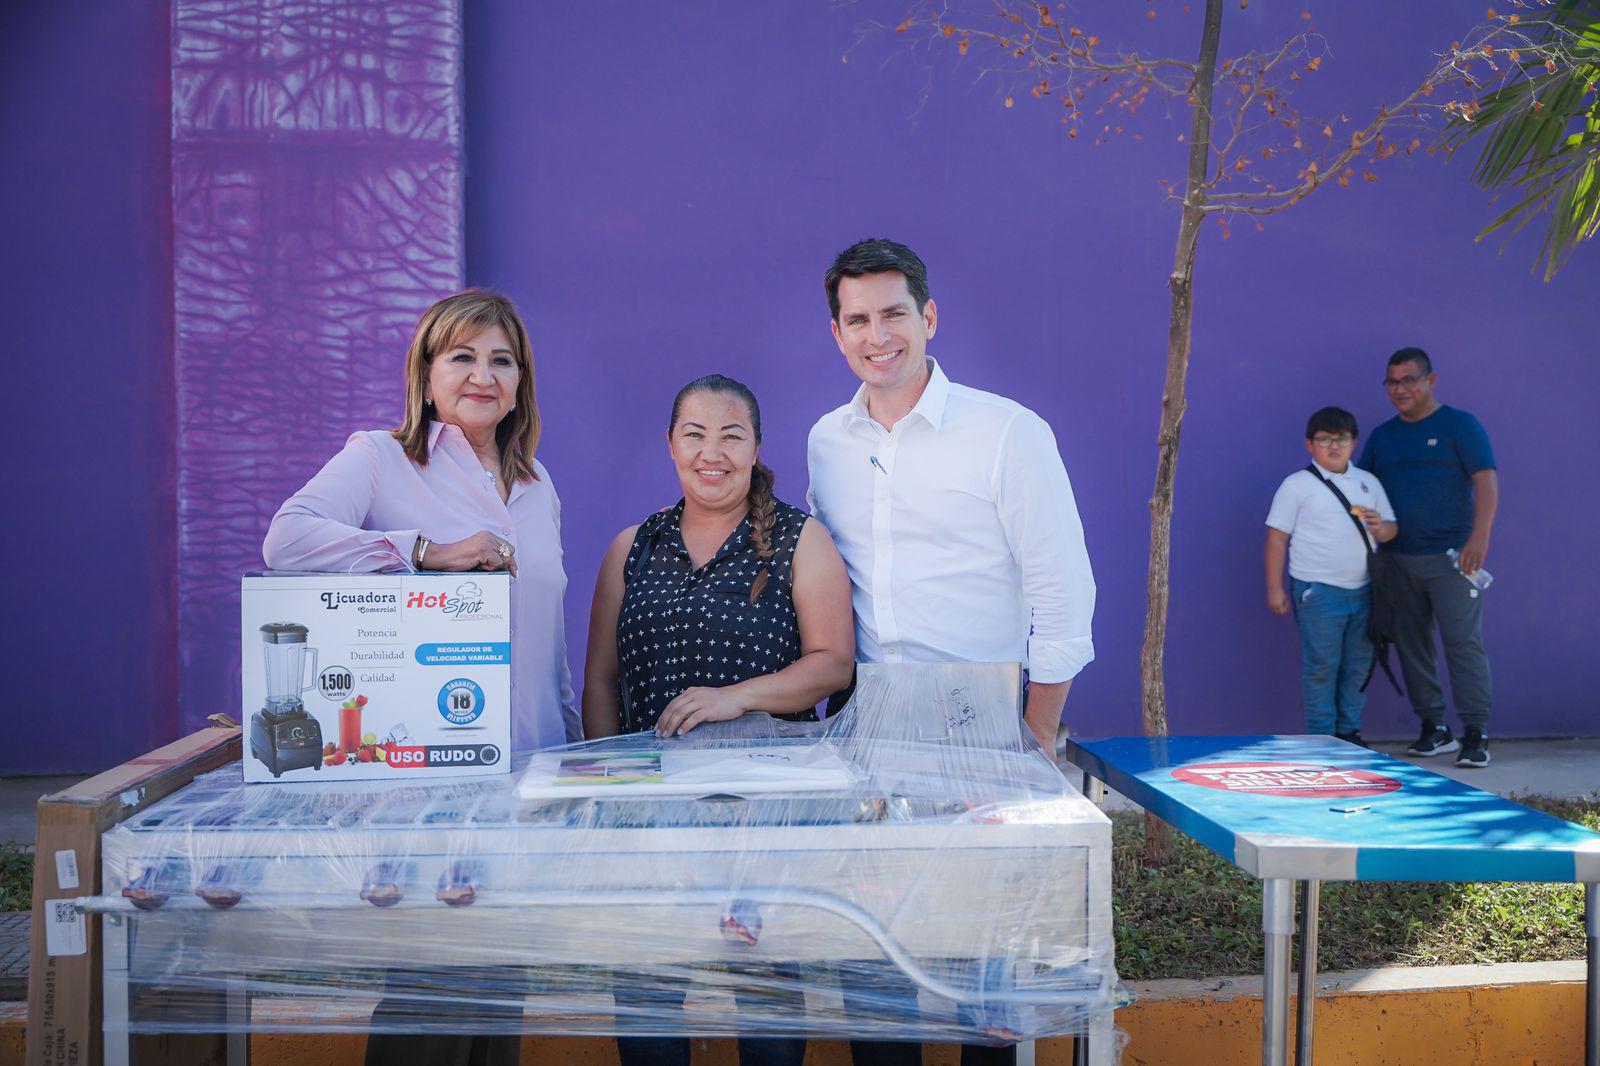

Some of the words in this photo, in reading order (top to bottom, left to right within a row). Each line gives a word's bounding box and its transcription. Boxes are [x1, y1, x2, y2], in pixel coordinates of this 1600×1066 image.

[320, 591, 397, 610] Licuadora
[407, 591, 447, 608] Hot
[443, 598, 485, 618] Spot
[357, 606, 397, 614] Comercial
[357, 628, 397, 638] Potencia
[350, 651, 405, 660] Durabilidad
[321, 673, 352, 691] 1,500
[360, 673, 395, 683] Calidad
[450, 689, 471, 710] 18
[390, 751, 425, 763] USO
[430, 749, 476, 762] RUDO
[56, 1028, 66, 1060] CHINA
